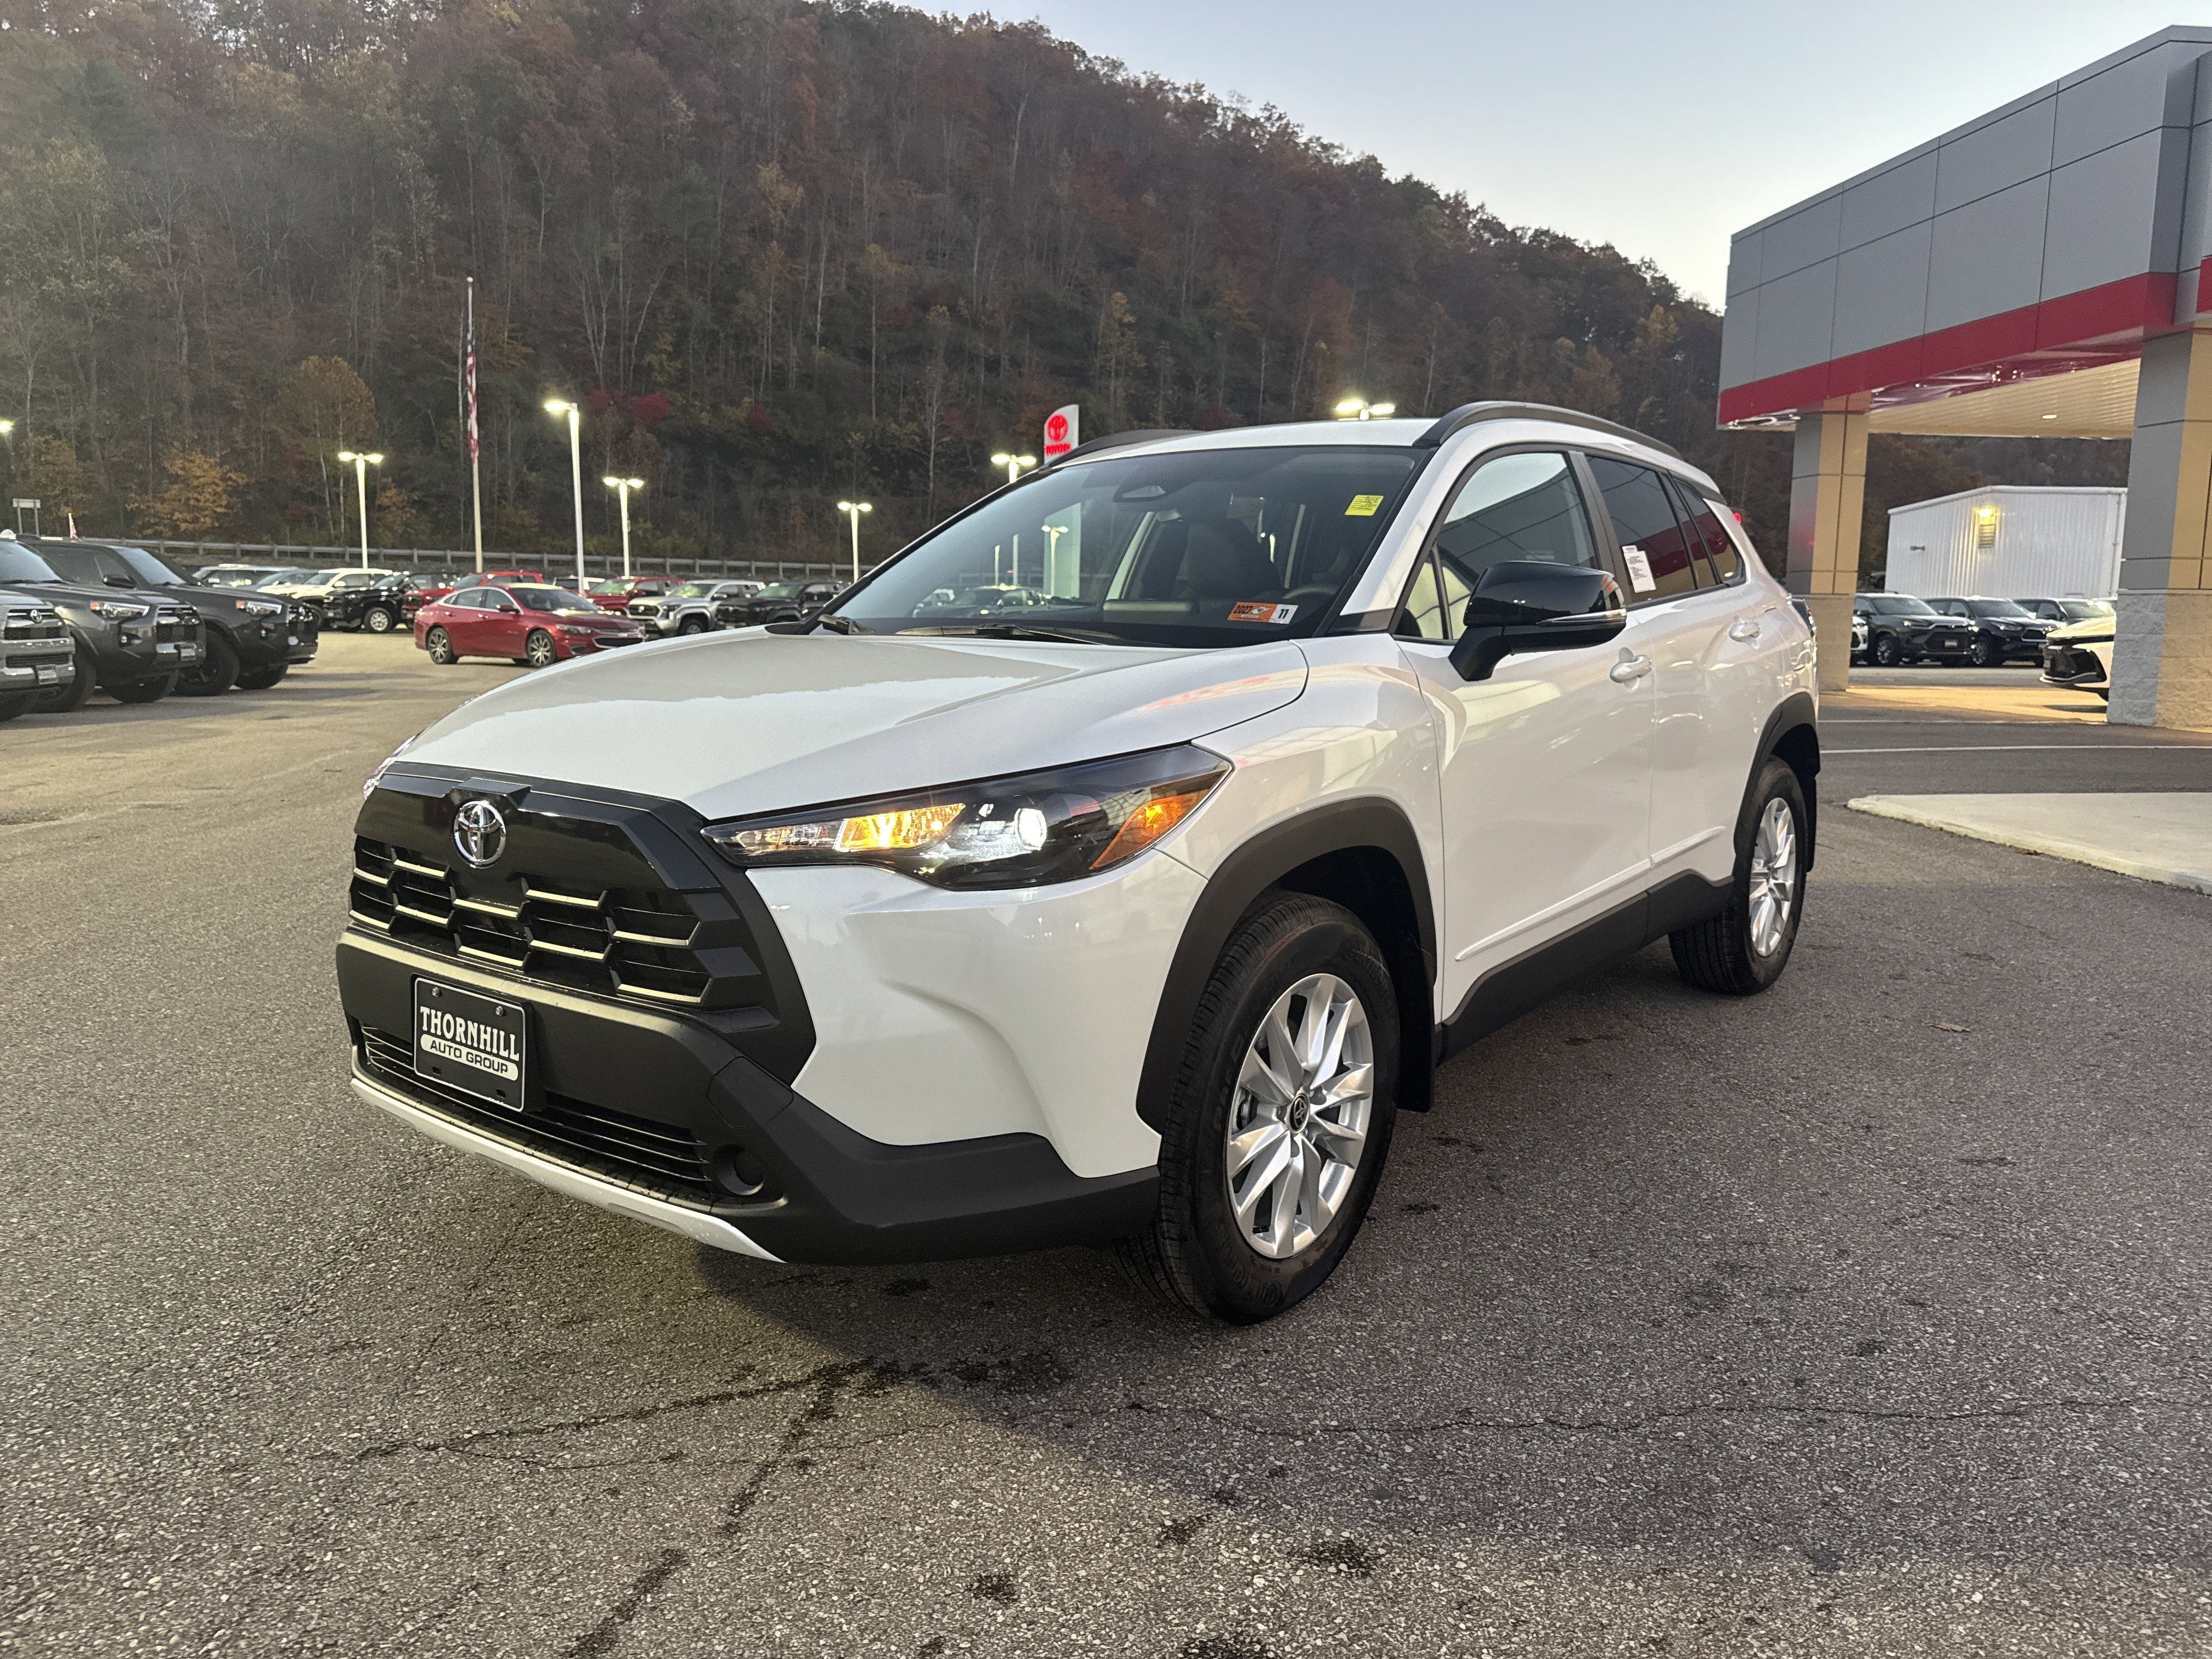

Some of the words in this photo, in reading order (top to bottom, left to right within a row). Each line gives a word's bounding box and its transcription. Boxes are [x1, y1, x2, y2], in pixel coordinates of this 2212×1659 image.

[1044, 443, 1071, 455] TOYOTA
[1233, 605, 1254, 614] 2027
[1278, 610, 1289, 619] 11
[420, 1006, 519, 1061] THORNHILL
[431, 1040, 462, 1058] AUTO
[466, 1052, 508, 1074] GROUP
